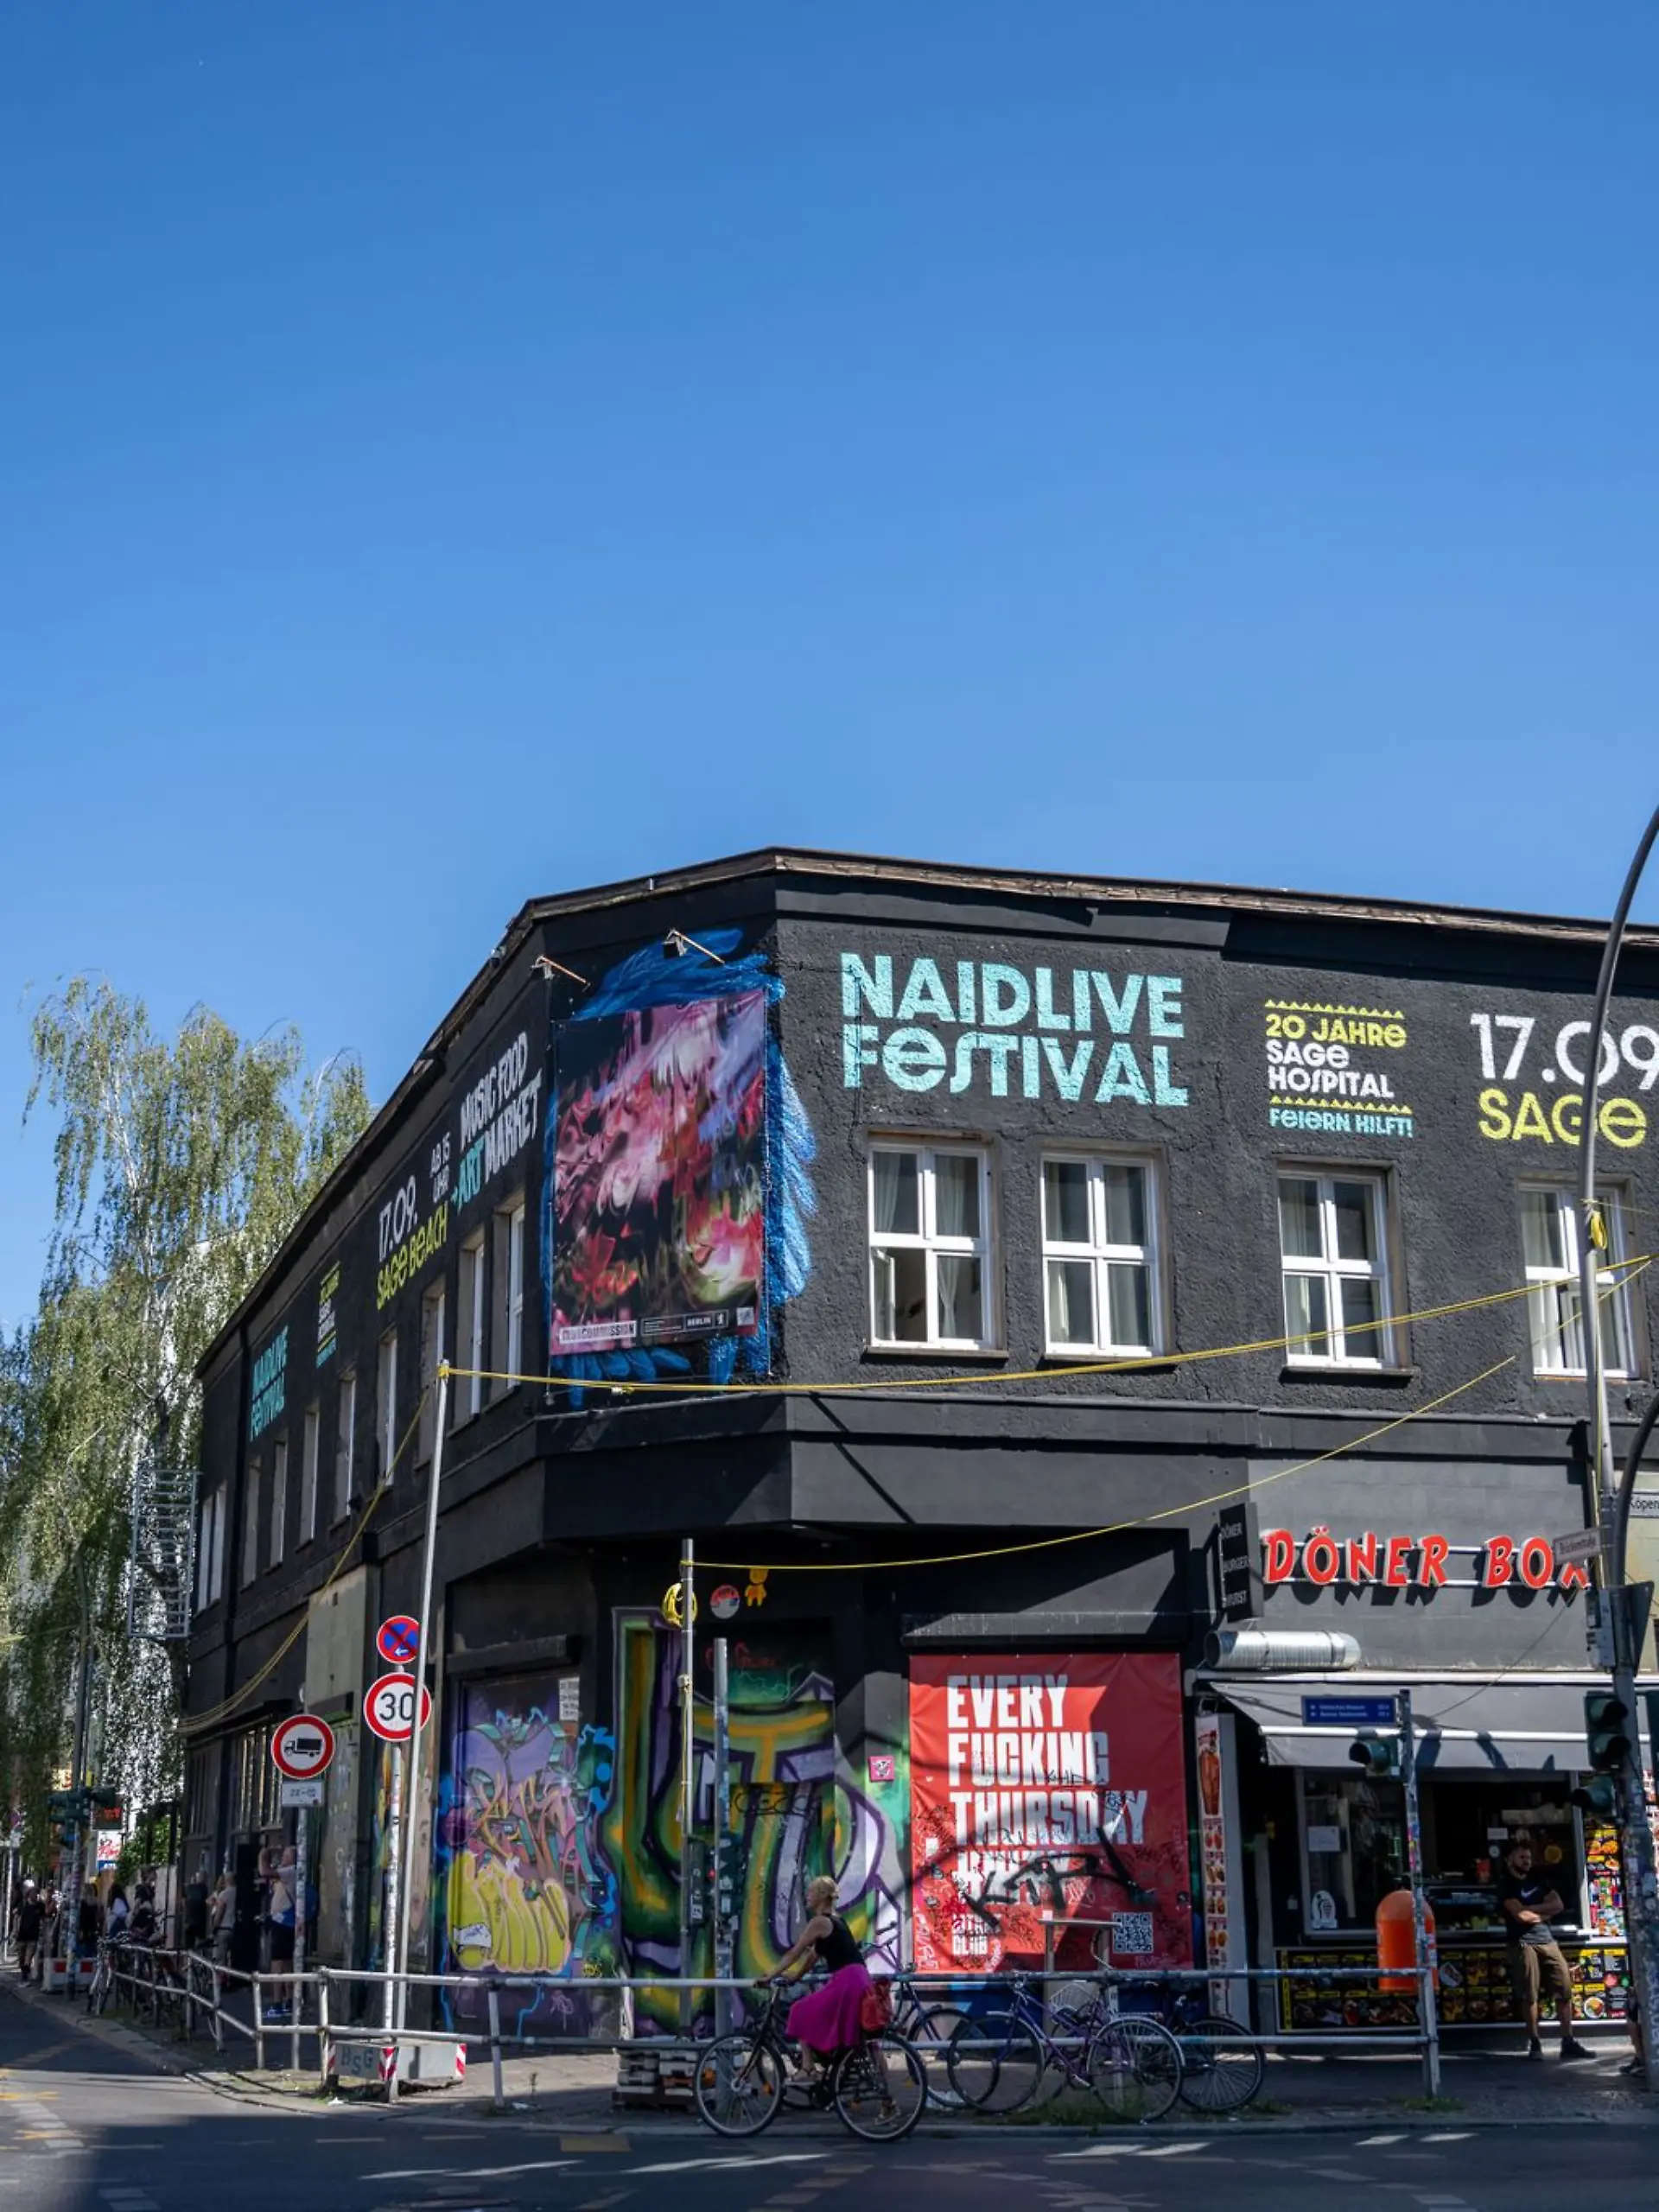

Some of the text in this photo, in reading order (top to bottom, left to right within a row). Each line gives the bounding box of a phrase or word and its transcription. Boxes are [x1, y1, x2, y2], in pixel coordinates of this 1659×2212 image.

[841, 952, 1185, 1038] NAIDLIVE
[1266, 1014, 1306, 1039] 20
[1268, 1065, 1395, 1099] HOSPITAL
[1261, 1524, 1449, 1588] DÖNER
[379, 1693, 416, 1721] 30
[947, 1675, 1068, 1728] EVERY
[948, 1732, 1109, 1787] FUCKING
[340, 2048, 374, 2075] BSG
